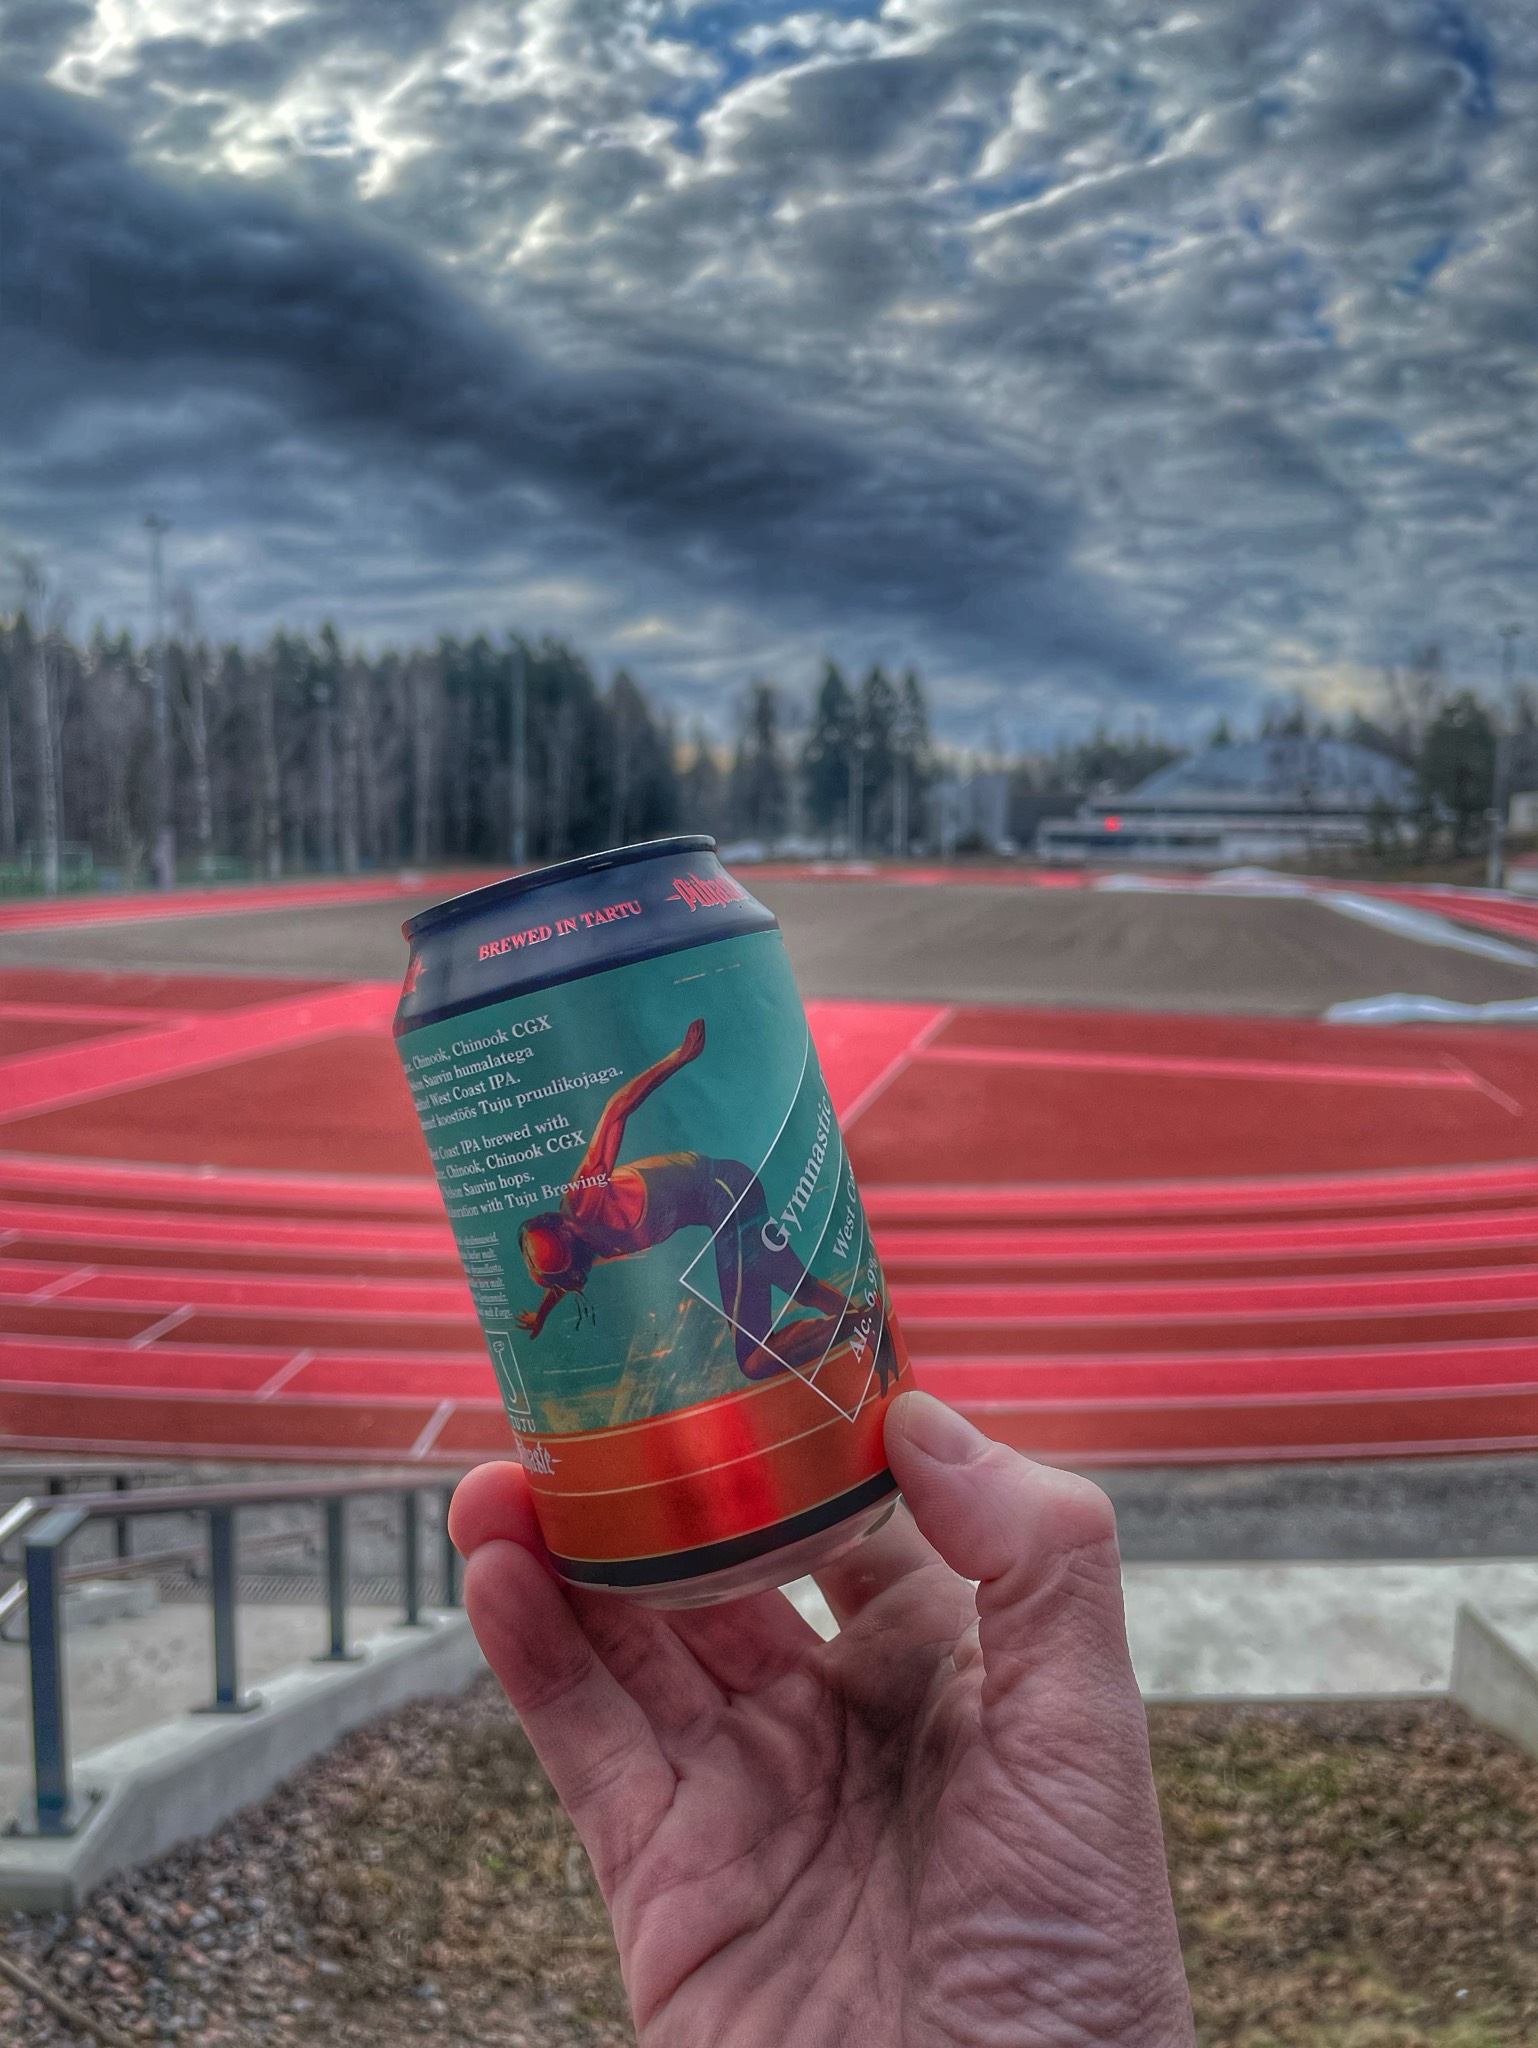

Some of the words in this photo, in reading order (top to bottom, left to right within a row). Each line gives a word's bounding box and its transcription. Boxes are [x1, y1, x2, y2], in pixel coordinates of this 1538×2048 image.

[478, 926, 553, 961] BREWED
[556, 917, 578, 938] IN
[580, 901, 643, 927] TARTU
[412, 1048, 451, 1070] Chinook,
[452, 1028, 509, 1057] Chinook
[511, 1015, 553, 1039] CGX
[422, 1070, 453, 1088] Sauvin
[454, 1046, 535, 1079] humalatega
[429, 1091, 452, 1107] West
[452, 1081, 487, 1100] Coast
[488, 1071, 521, 1092] IPA.
[478, 1097, 513, 1116] Tuju
[515, 1066, 624, 1105] pruulikojaga.
[446, 1159, 485, 1179] Chinook,
[485, 1144, 545, 1171] Chinook
[546, 1130, 587, 1154] CGX
[460, 1138, 482, 1154] IPA
[482, 1128, 533, 1150] brewed
[534, 1114, 571, 1136] with
[462, 1178, 497, 1197] Sauvin
[497, 1173, 536, 1191] hops.
[480, 1197, 505, 1214] with
[504, 1191, 539, 1213] Tuju
[541, 1171, 612, 1201] Brewing.
[832, 1204, 856, 1259] West
[849, 1317, 872, 1364] Alc.
